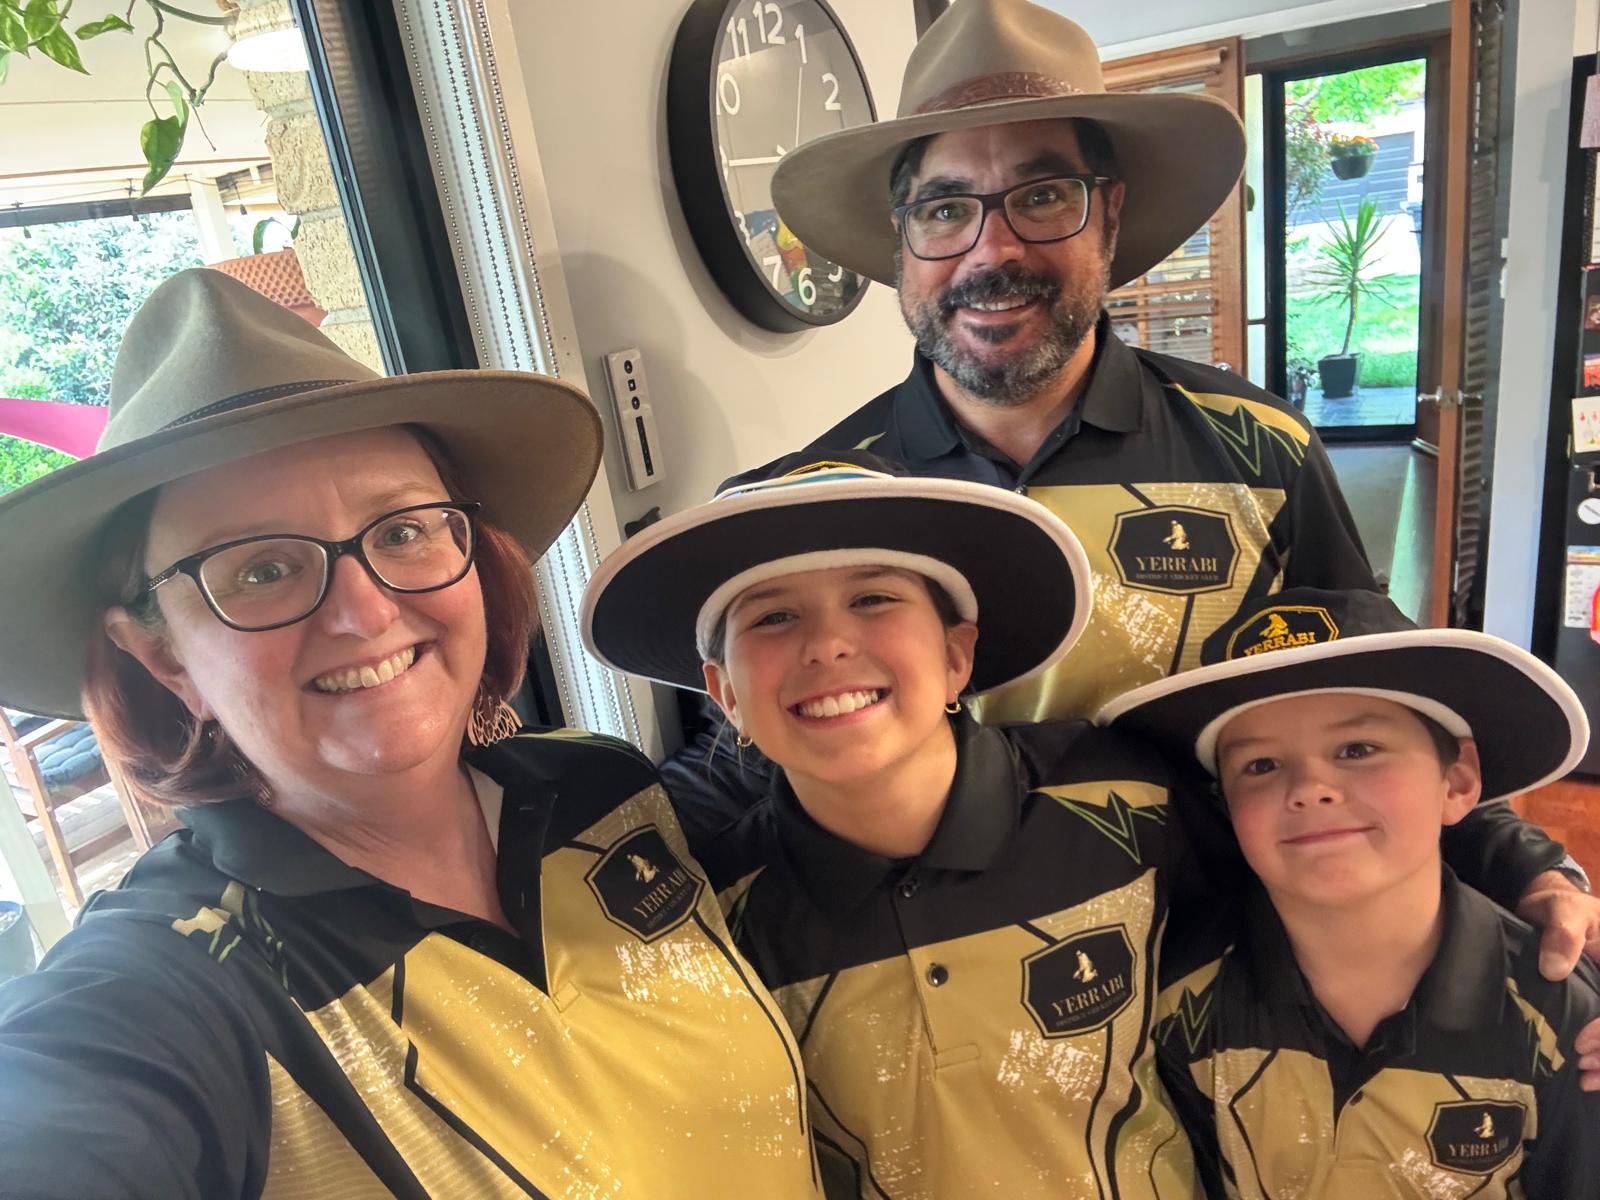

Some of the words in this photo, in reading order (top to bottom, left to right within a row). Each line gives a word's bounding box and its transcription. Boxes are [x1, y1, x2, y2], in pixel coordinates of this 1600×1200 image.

[726, 16, 751, 60] 11
[752, 1, 786, 45] 12
[794, 23, 808, 64] 1
[822, 72, 842, 111] 2
[762, 254, 782, 291] 7
[798, 267, 817, 306] 6
[1135, 556, 1218, 572] YERRABI
[1051, 973, 1125, 1017] YERRABI
